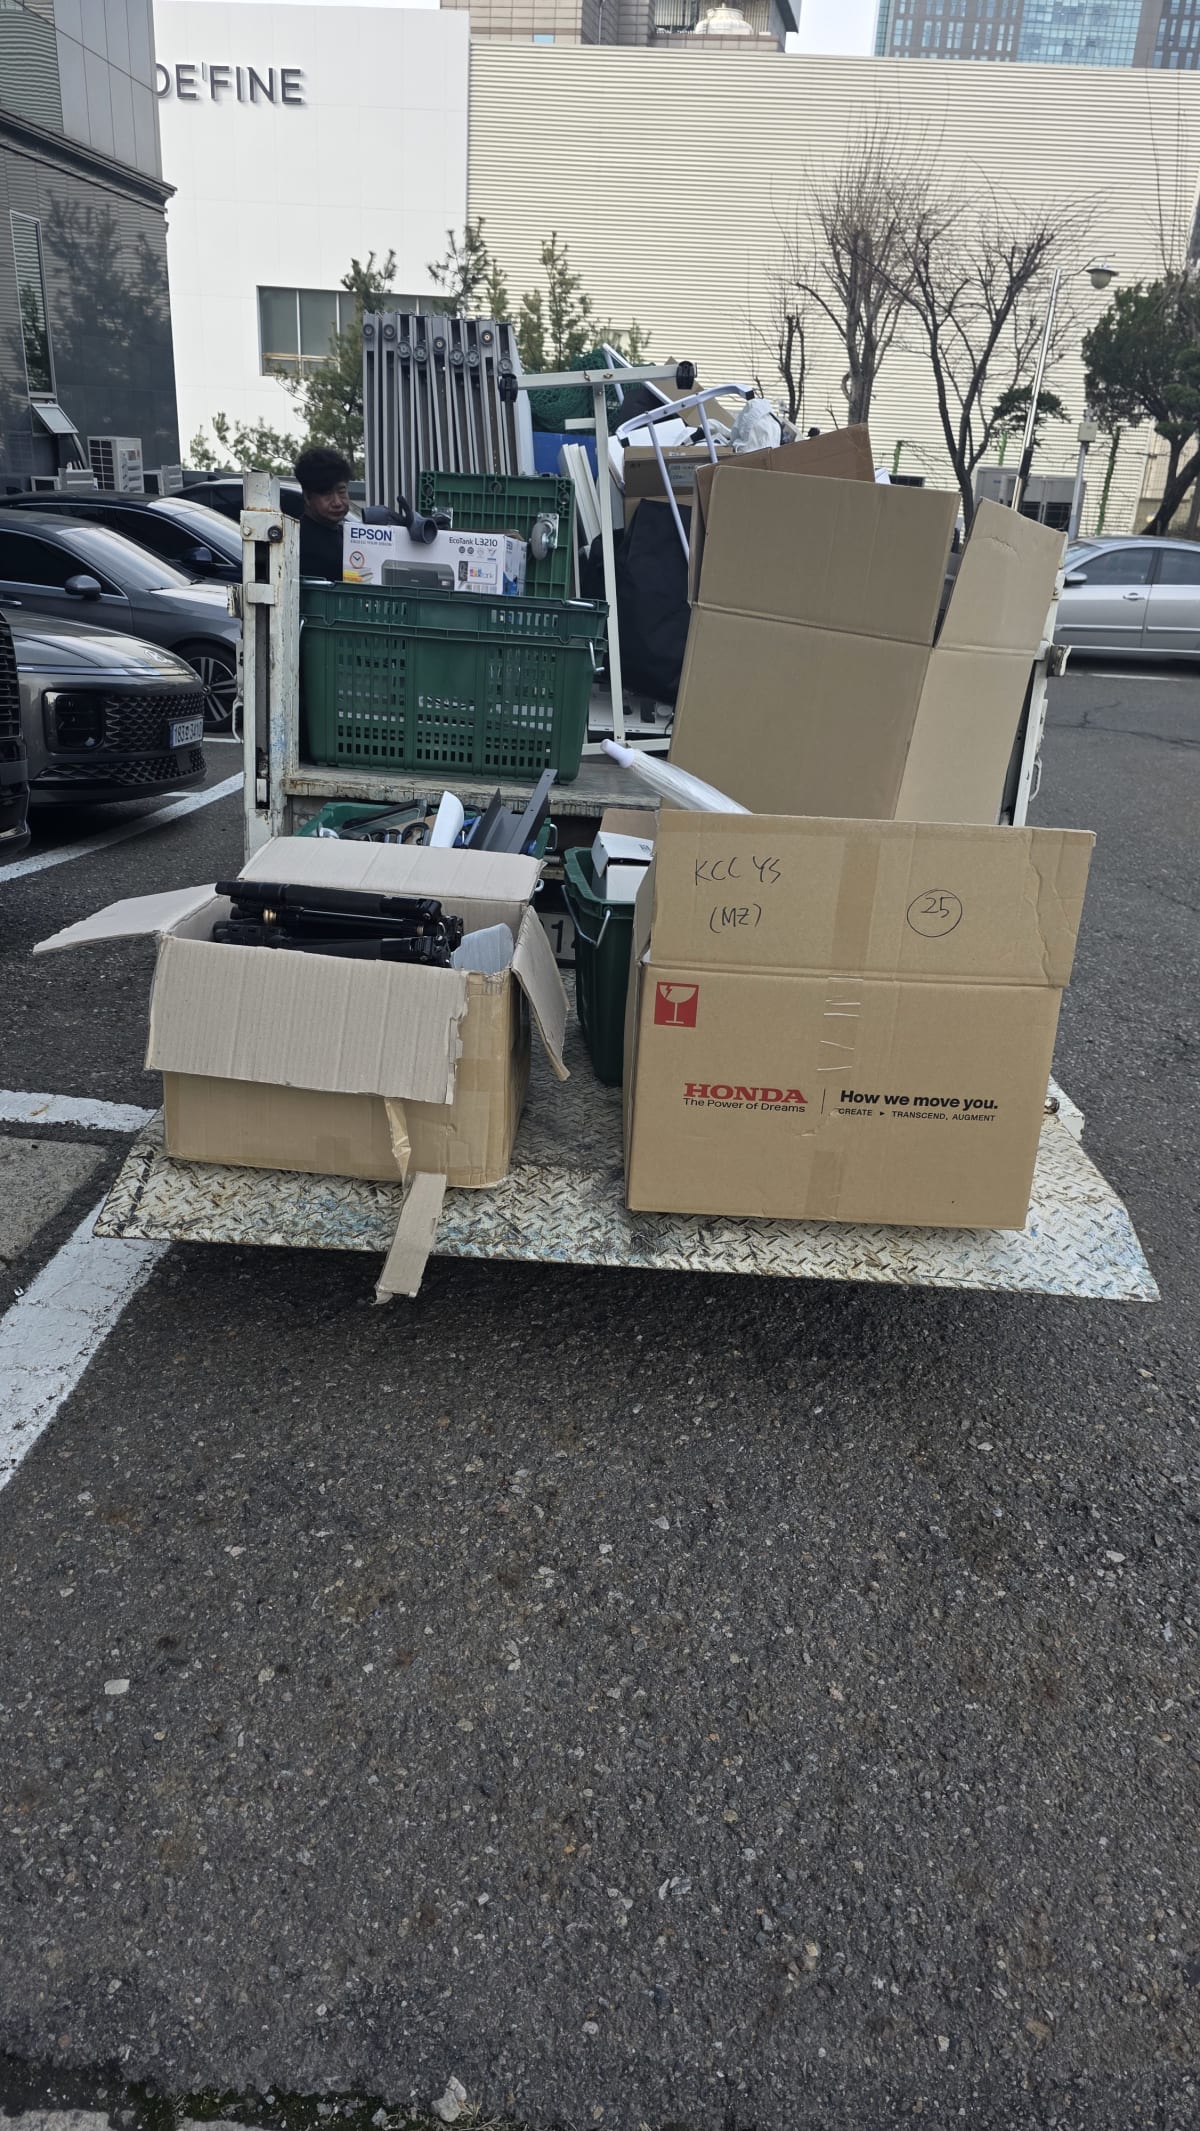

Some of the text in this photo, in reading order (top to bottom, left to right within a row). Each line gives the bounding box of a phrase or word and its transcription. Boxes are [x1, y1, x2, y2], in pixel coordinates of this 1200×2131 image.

[350, 528, 392, 541] EPSON
[449, 536, 473, 545] EcoTank
[474, 538, 498, 547] L3210
[694, 856, 741, 886] KCC
[920, 896, 953, 918] 25
[709, 903, 762, 934] (MZ)
[683, 1082, 809, 1104] HONDA
[840, 1090, 999, 1111] How we move you.
[683, 1097, 806, 1113] The Power of Dreams
[838, 1108, 873, 1117] CREATE
[952, 1113, 996, 1122] AUGMENT
